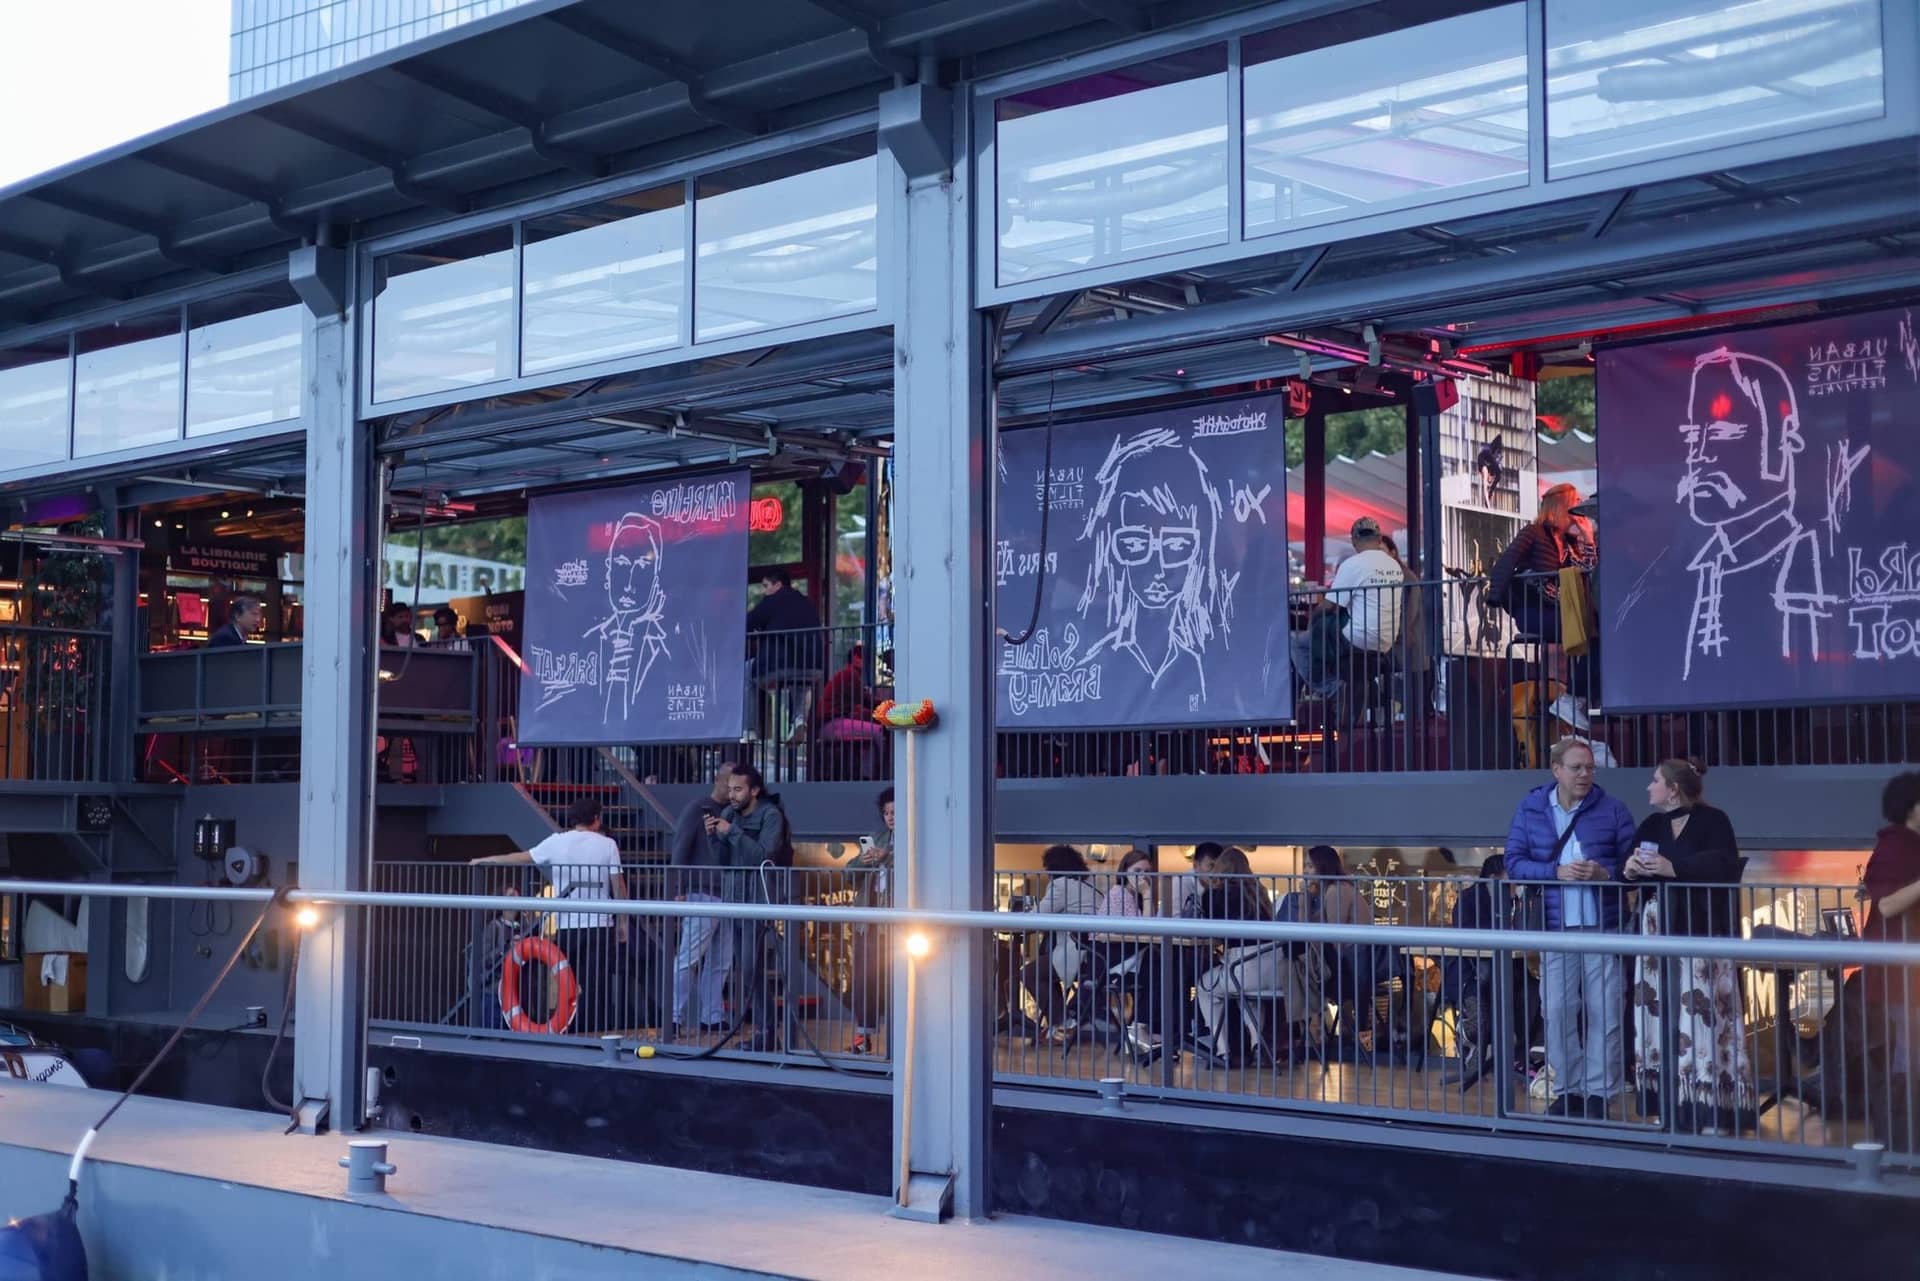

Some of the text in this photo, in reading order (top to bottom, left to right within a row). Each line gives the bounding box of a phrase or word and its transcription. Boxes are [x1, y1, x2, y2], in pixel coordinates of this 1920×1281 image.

[181, 546, 268, 561] LA LIBRAIRIE
[191, 558, 259, 571] BOUTIQUE
